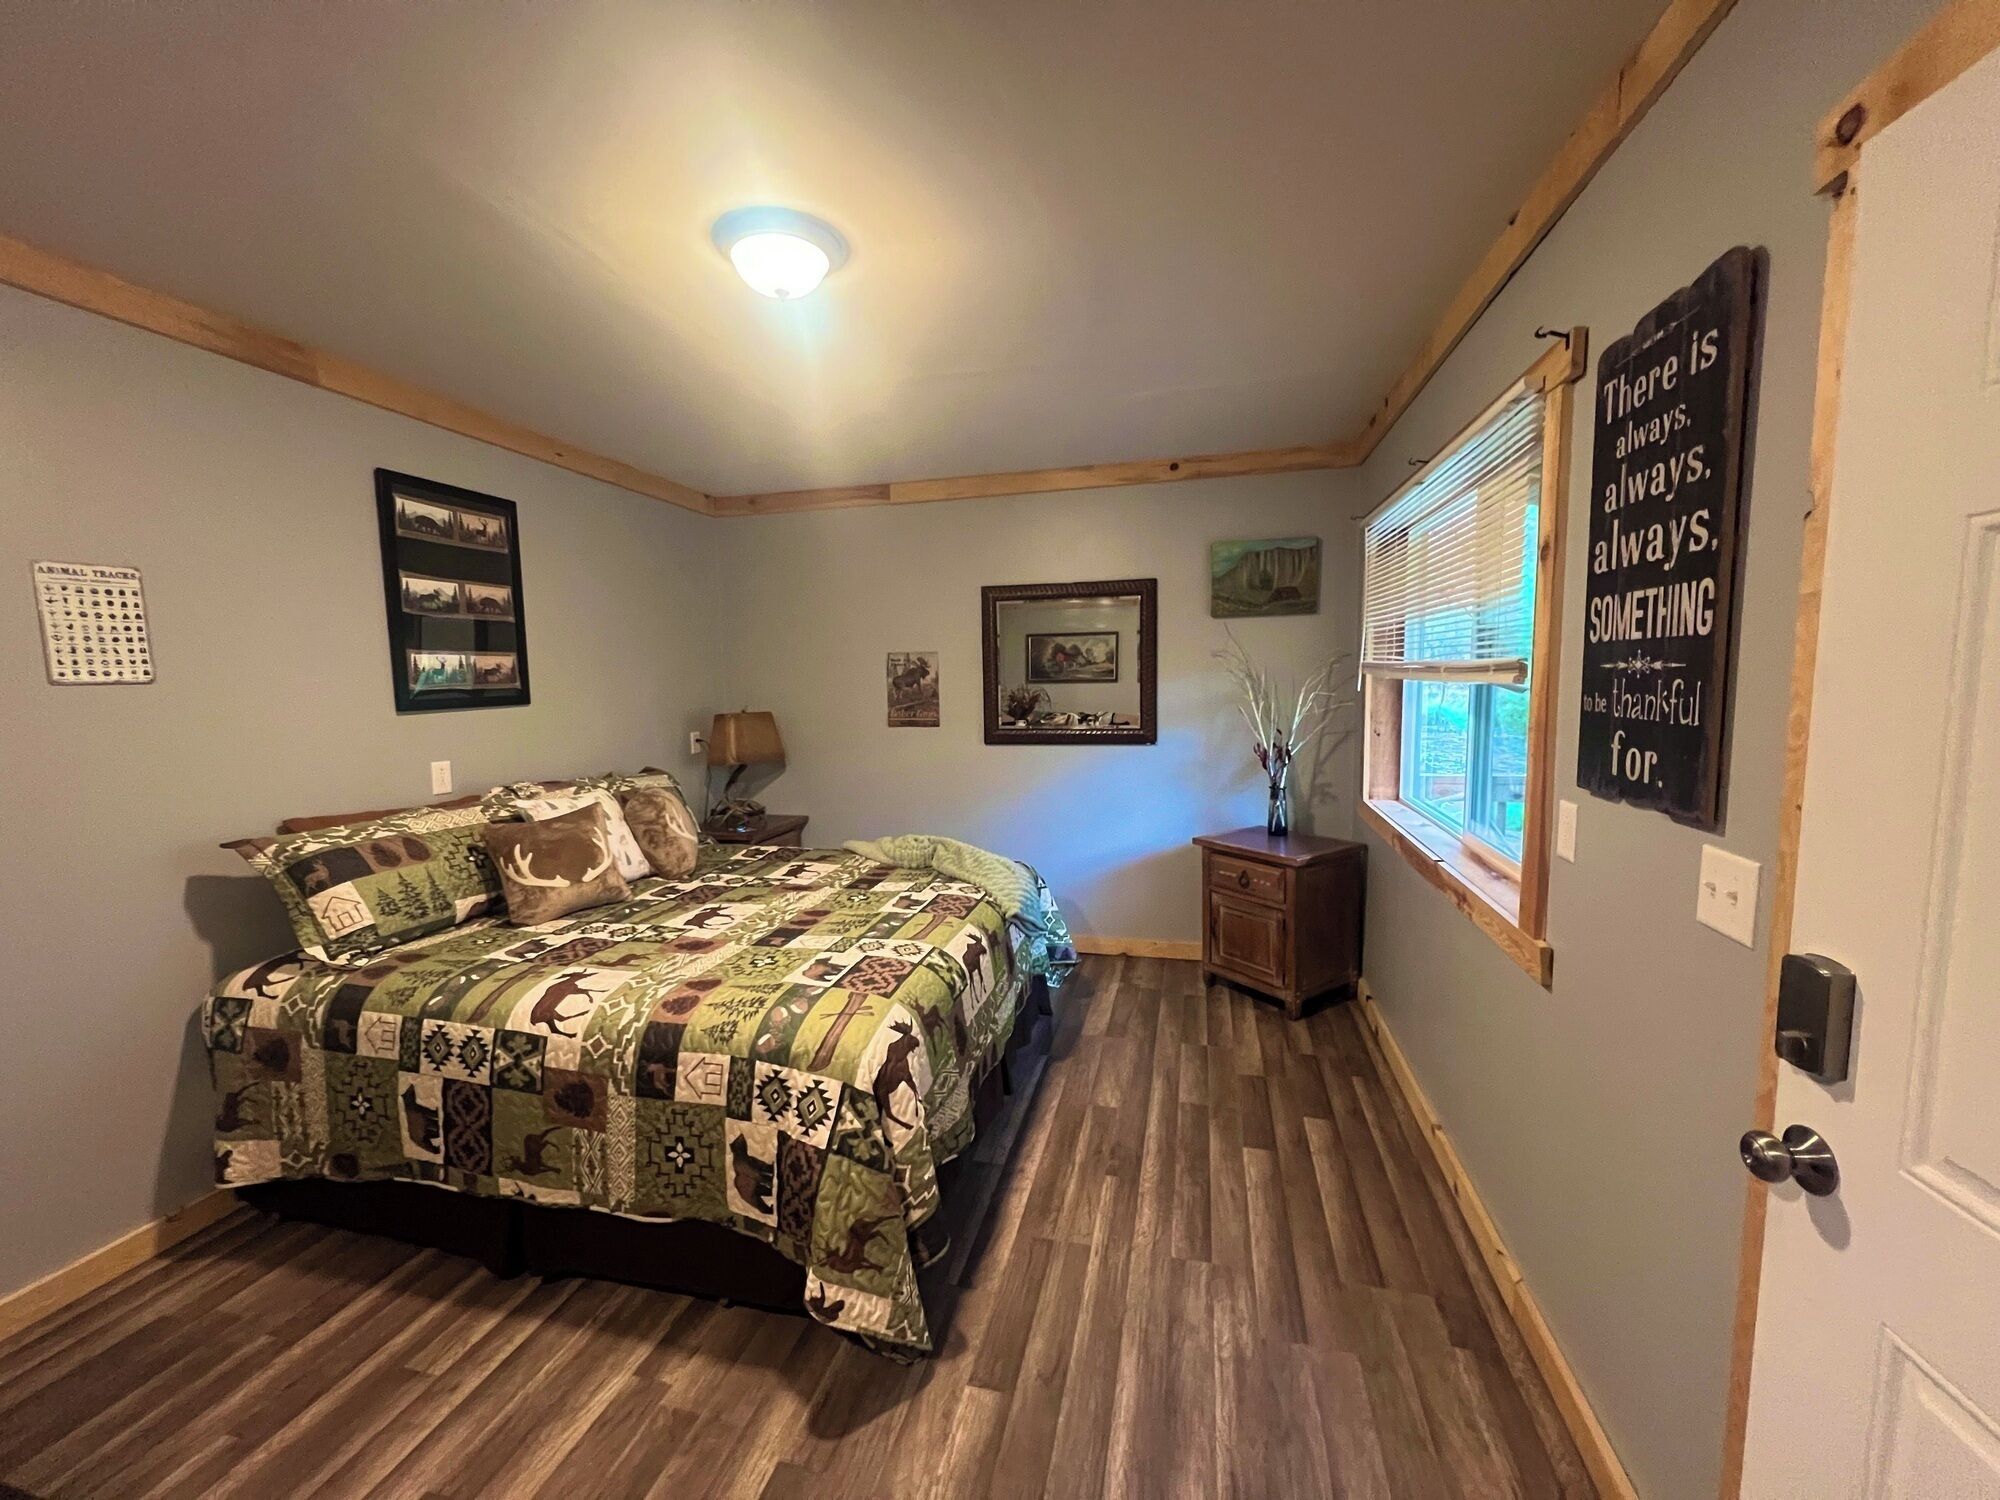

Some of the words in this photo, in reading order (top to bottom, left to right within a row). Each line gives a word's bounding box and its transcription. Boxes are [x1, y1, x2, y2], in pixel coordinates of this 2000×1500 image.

[1603, 355, 1678, 425] There
[1690, 328, 1719, 376] is
[37, 565, 88, 577] ANIMAL
[92, 570, 137, 580] TRACKS
[1589, 577, 1716, 644] SOMETHING
[1583, 693, 1593, 713] to
[1595, 692, 1607, 714] be
[1612, 678, 1702, 727] thankful
[1611, 730, 1663, 789] for.
